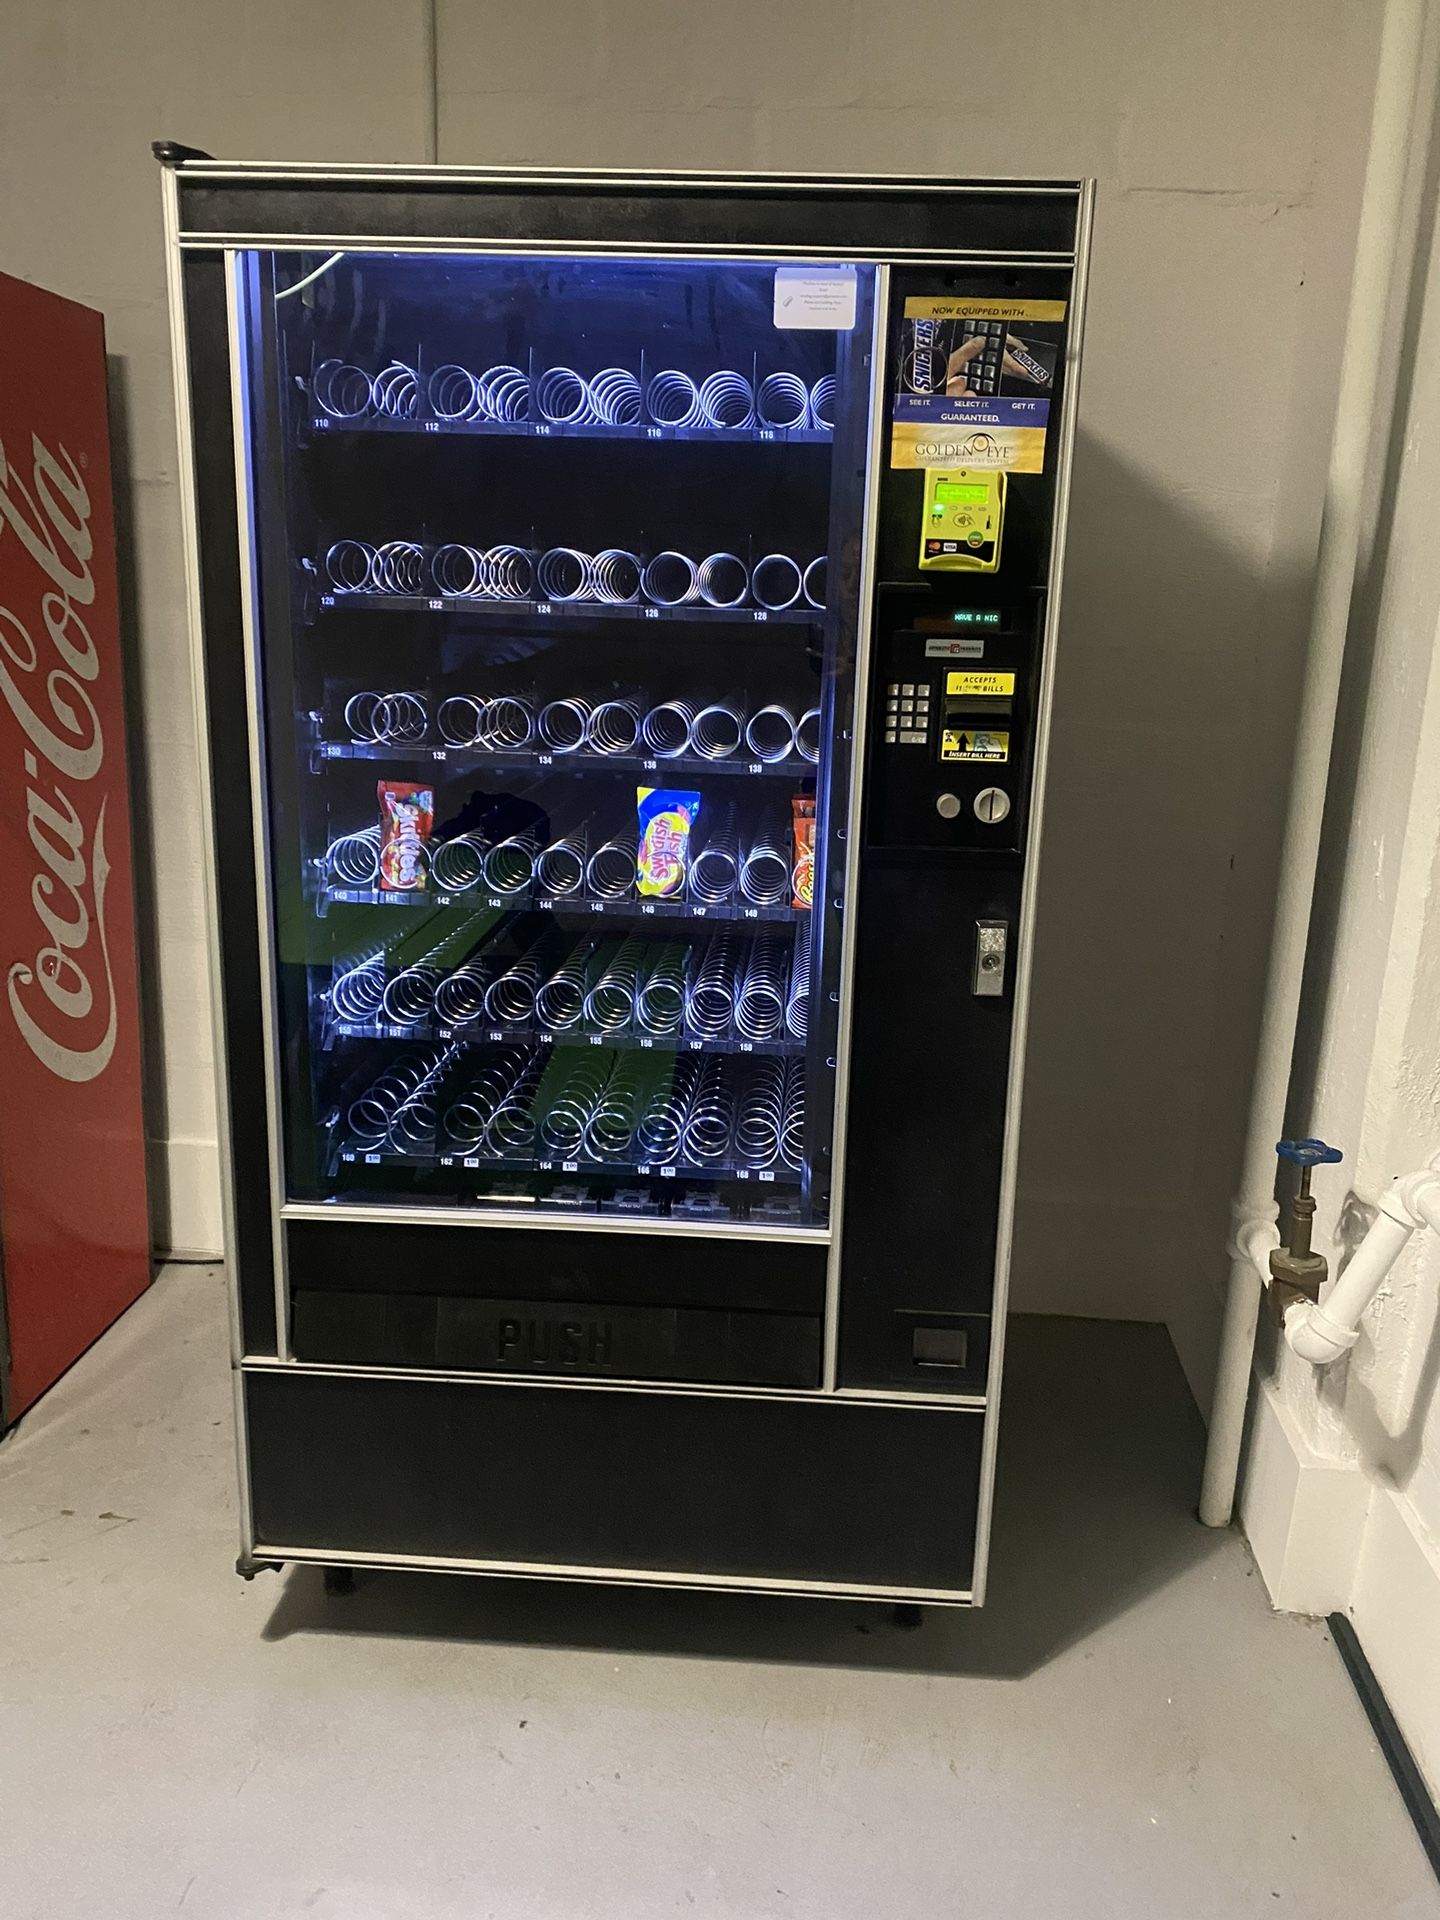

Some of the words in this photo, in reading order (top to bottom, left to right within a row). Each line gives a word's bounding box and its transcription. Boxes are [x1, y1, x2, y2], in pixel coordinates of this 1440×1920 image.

[932, 307, 953, 315] NOW
[956, 307, 1000, 316] EQUIPPED
[1012, 350, 1048, 380] SNICKERS
[940, 413, 1000, 423] GUARANTEED.
[314, 419, 329, 428] 110
[424, 422, 440, 431] 112
[535, 425, 550, 434] 114
[646, 429, 662, 438] 116
[759, 430, 774, 439] 118
[915, 443, 974, 457] GOLDEN
[987, 446, 1010, 459] EYE
[321, 597, 335, 606] 120
[428, 600, 443, 609] 122
[537, 604, 551, 614] 124
[645, 609, 659, 618] 126
[753, 612, 768, 621] 128
[954, 614, 972, 622] HAVE
[984, 614, 998, 622] NIC
[0, 432, 117, 1084] Coca-Cola
[432, 751, 446, 760] 132
[538, 756, 552, 765] 134
[437, 896, 450, 905] 142
[488, 898, 501, 908] 143
[539, 901, 552, 910] 144
[590, 903, 603, 912] 145
[641, 905, 654, 914] 146
[692, 907, 706, 916] 147
[744, 909, 758, 918] 148
[388, 1027, 401, 1037] 151
[439, 1030, 452, 1039] 152
[489, 1032, 502, 1041] 153
[539, 1034, 552, 1043] 154
[589, 1036, 602, 1045] 155
[640, 1039, 653, 1048] 156
[689, 1041, 703, 1050] 157
[440, 1157, 453, 1166] 162
[539, 1161, 552, 1171] 164
[496, 1318, 612, 1367] PUSH
